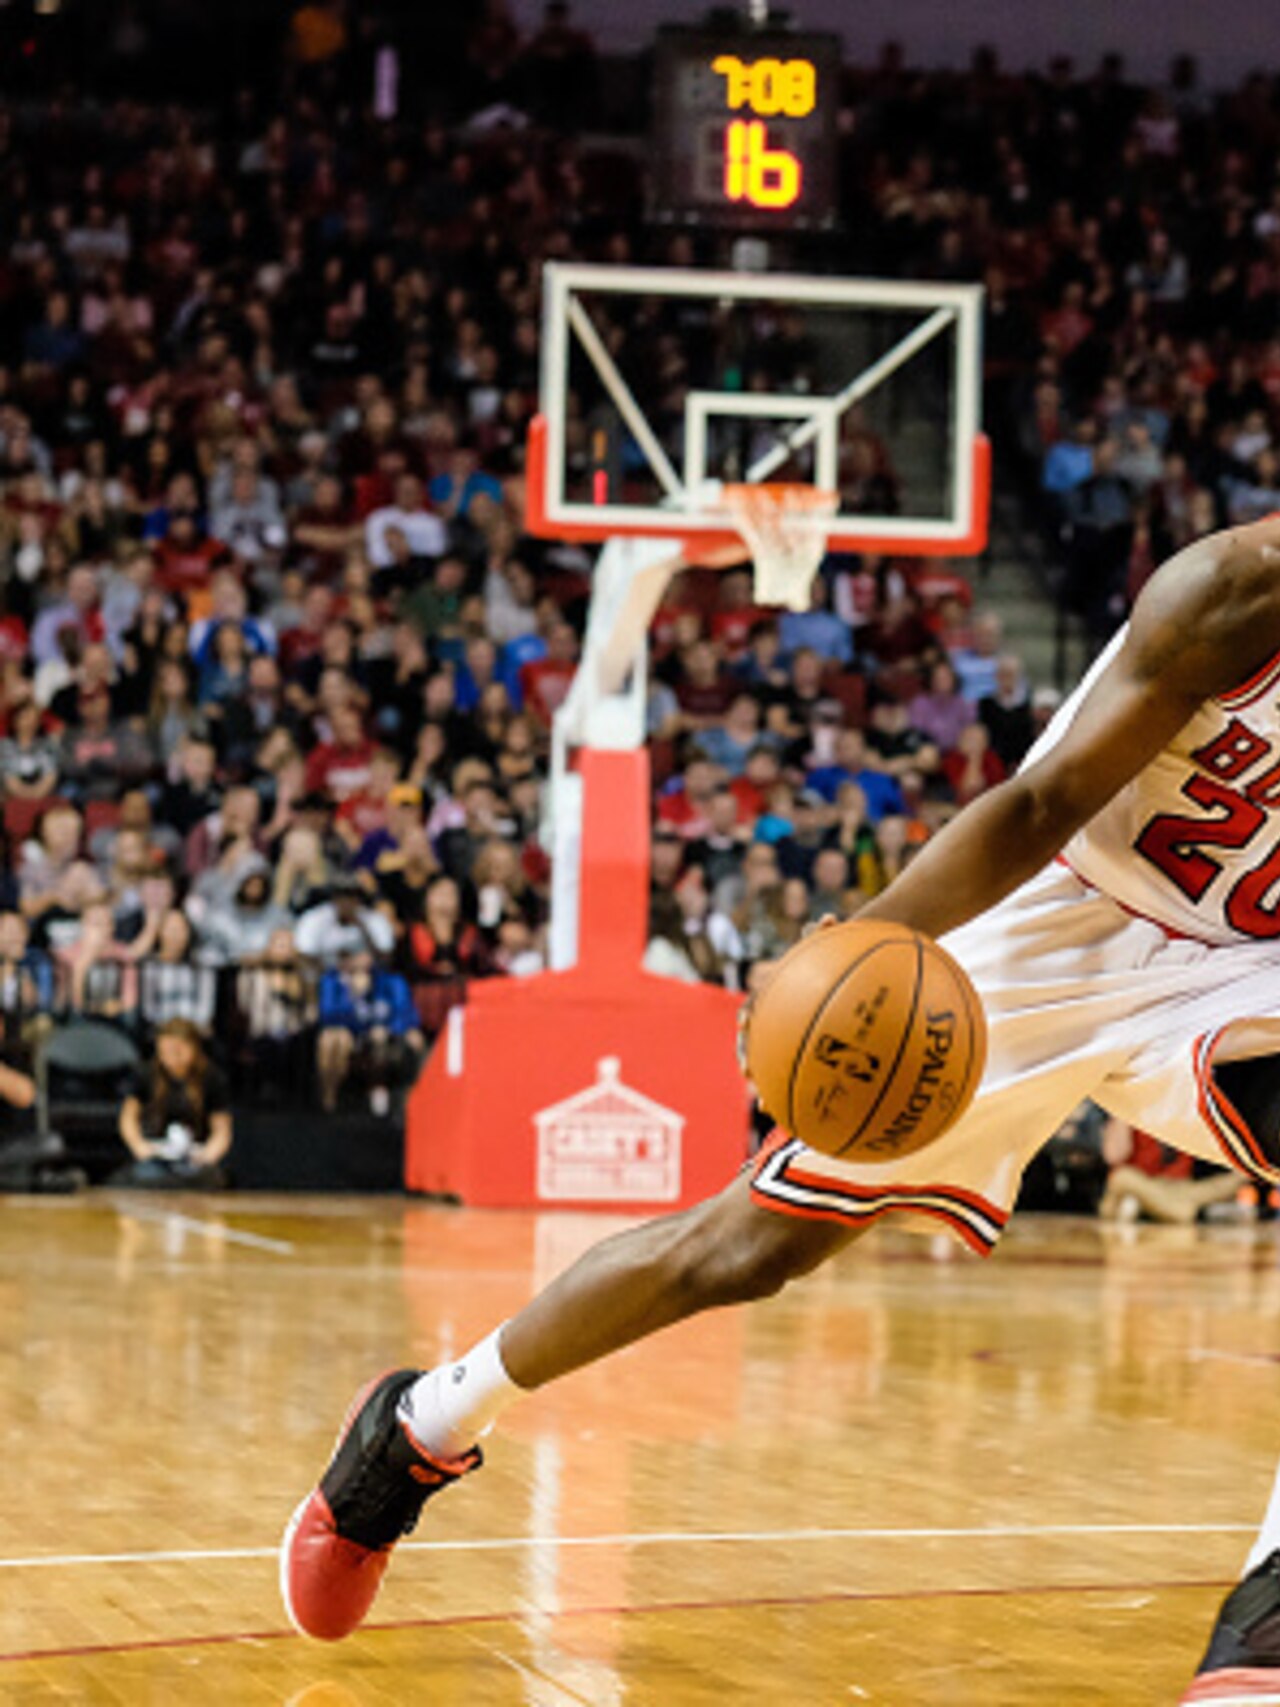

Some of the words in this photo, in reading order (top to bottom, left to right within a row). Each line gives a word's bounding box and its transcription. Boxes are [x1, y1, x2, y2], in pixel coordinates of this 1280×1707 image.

[711, 55, 816, 118] 7:08
[725, 119, 802, 209] 16
[863, 1003, 957, 1151] SPALDING
